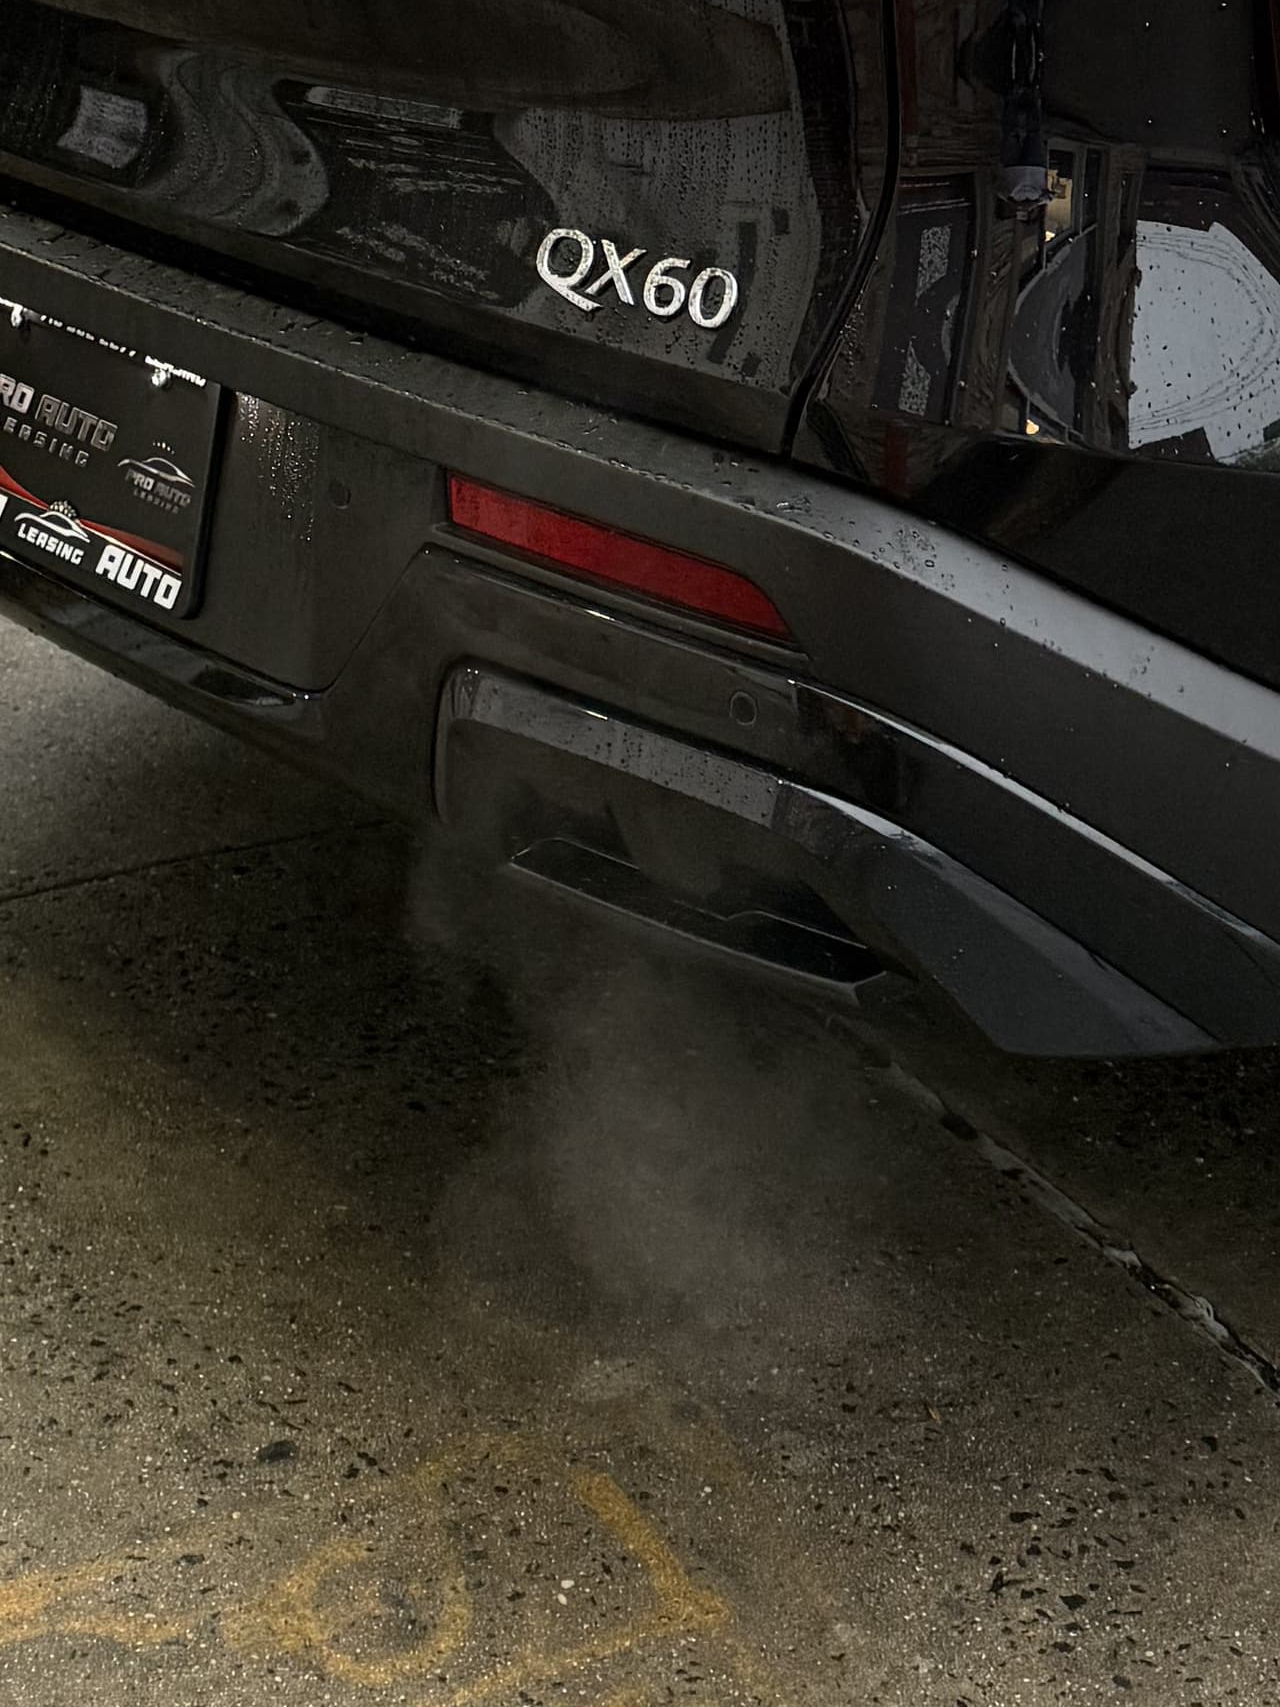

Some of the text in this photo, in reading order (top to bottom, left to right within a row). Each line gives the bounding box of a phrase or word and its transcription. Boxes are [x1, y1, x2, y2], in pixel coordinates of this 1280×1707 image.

[536, 228, 738, 329] QX60
[35, 394, 118, 451] AUTO
[125, 468, 155, 491] PRO
[17, 523, 84, 565] LEASING
[95, 544, 182, 610] AUTO
